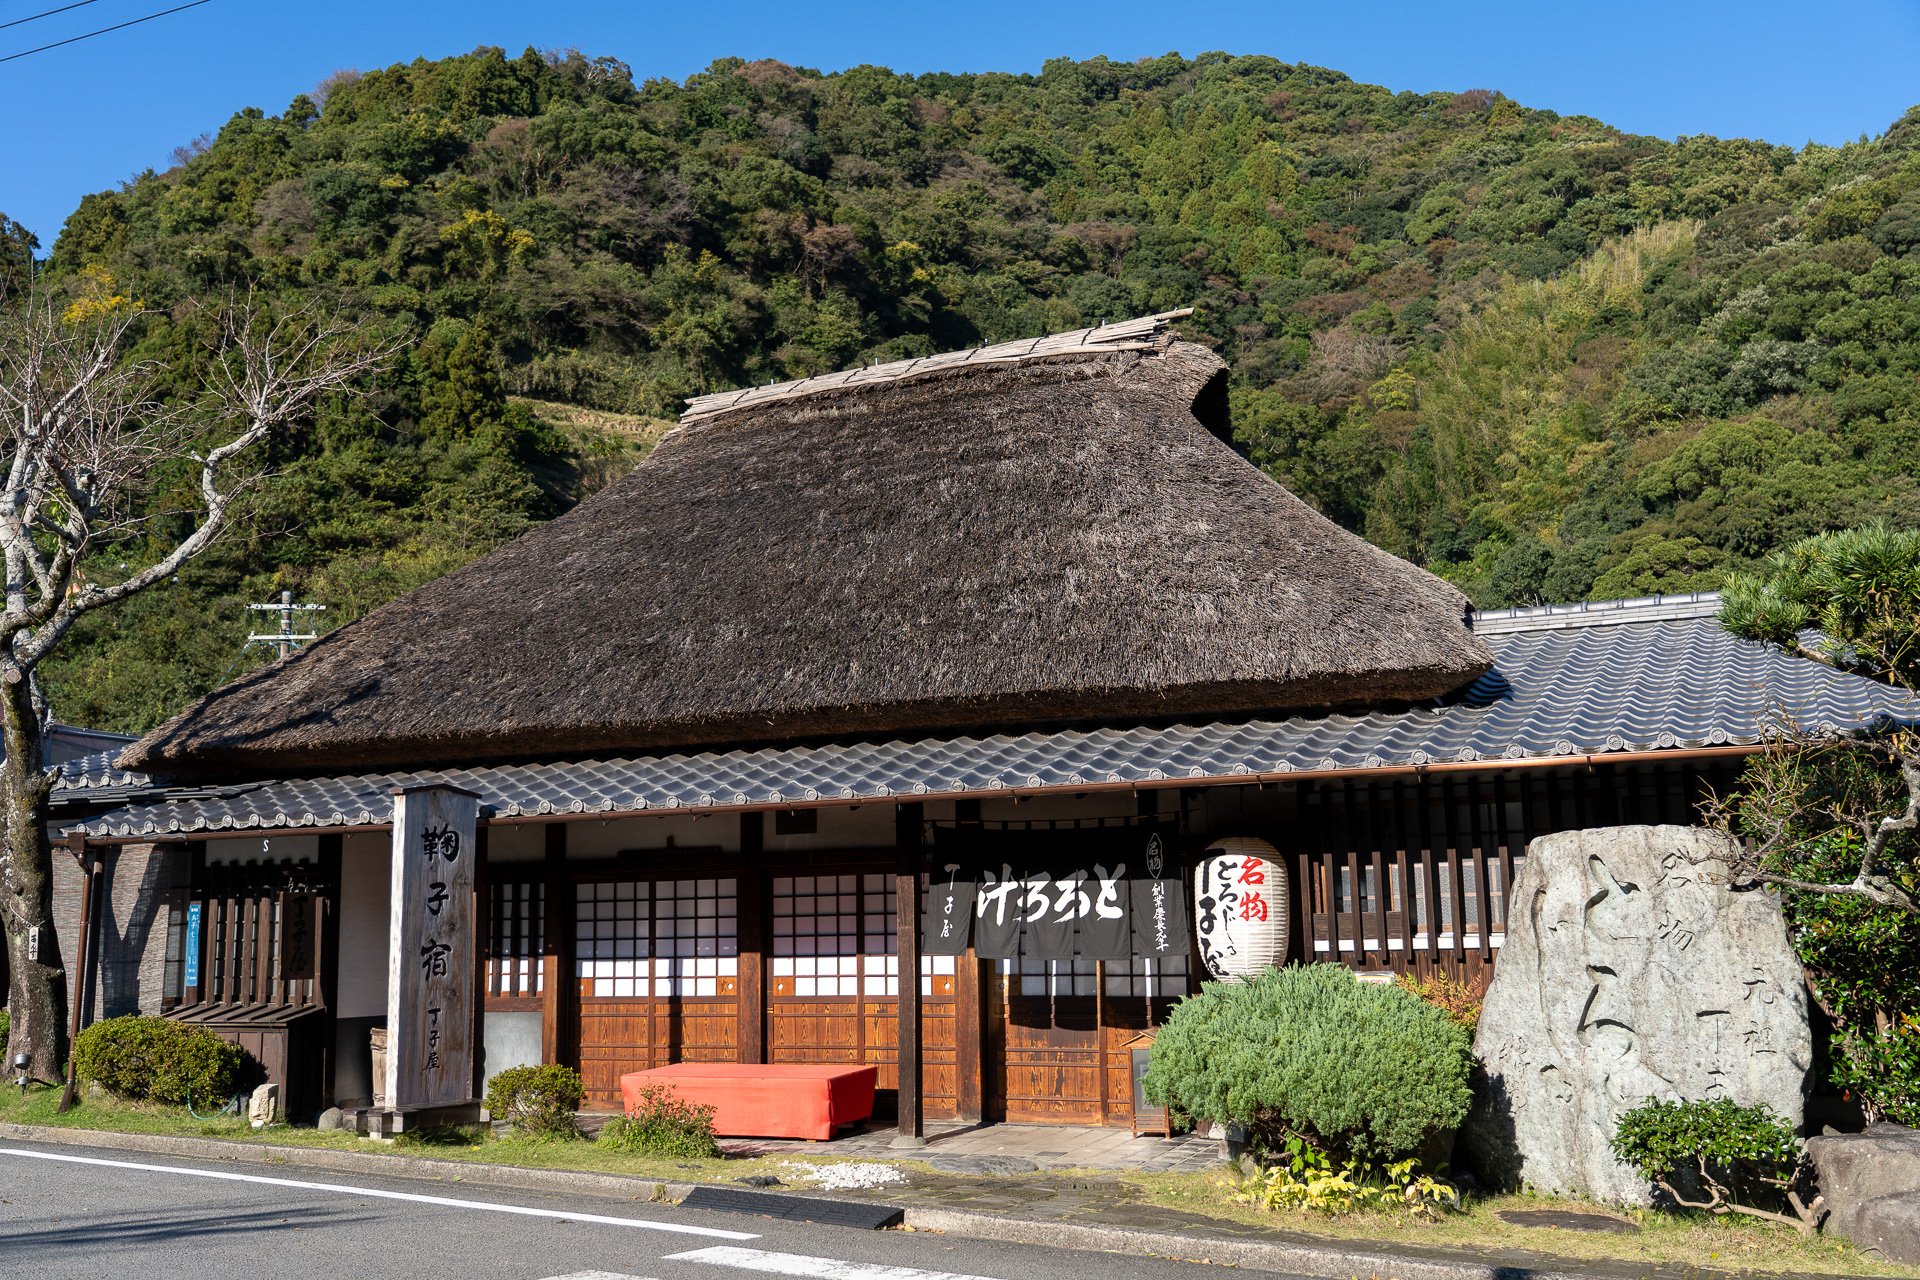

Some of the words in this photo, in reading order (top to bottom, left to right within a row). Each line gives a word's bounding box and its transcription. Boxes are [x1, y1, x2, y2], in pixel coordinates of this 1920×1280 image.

[1148, 841, 1161, 870] 名物
[421, 824, 460, 981] 鞠子宿
[1237, 856, 1268, 922] 名物
[423, 1008, 441, 1071] 丁子屋
[1742, 967, 1777, 1057] 元祖
